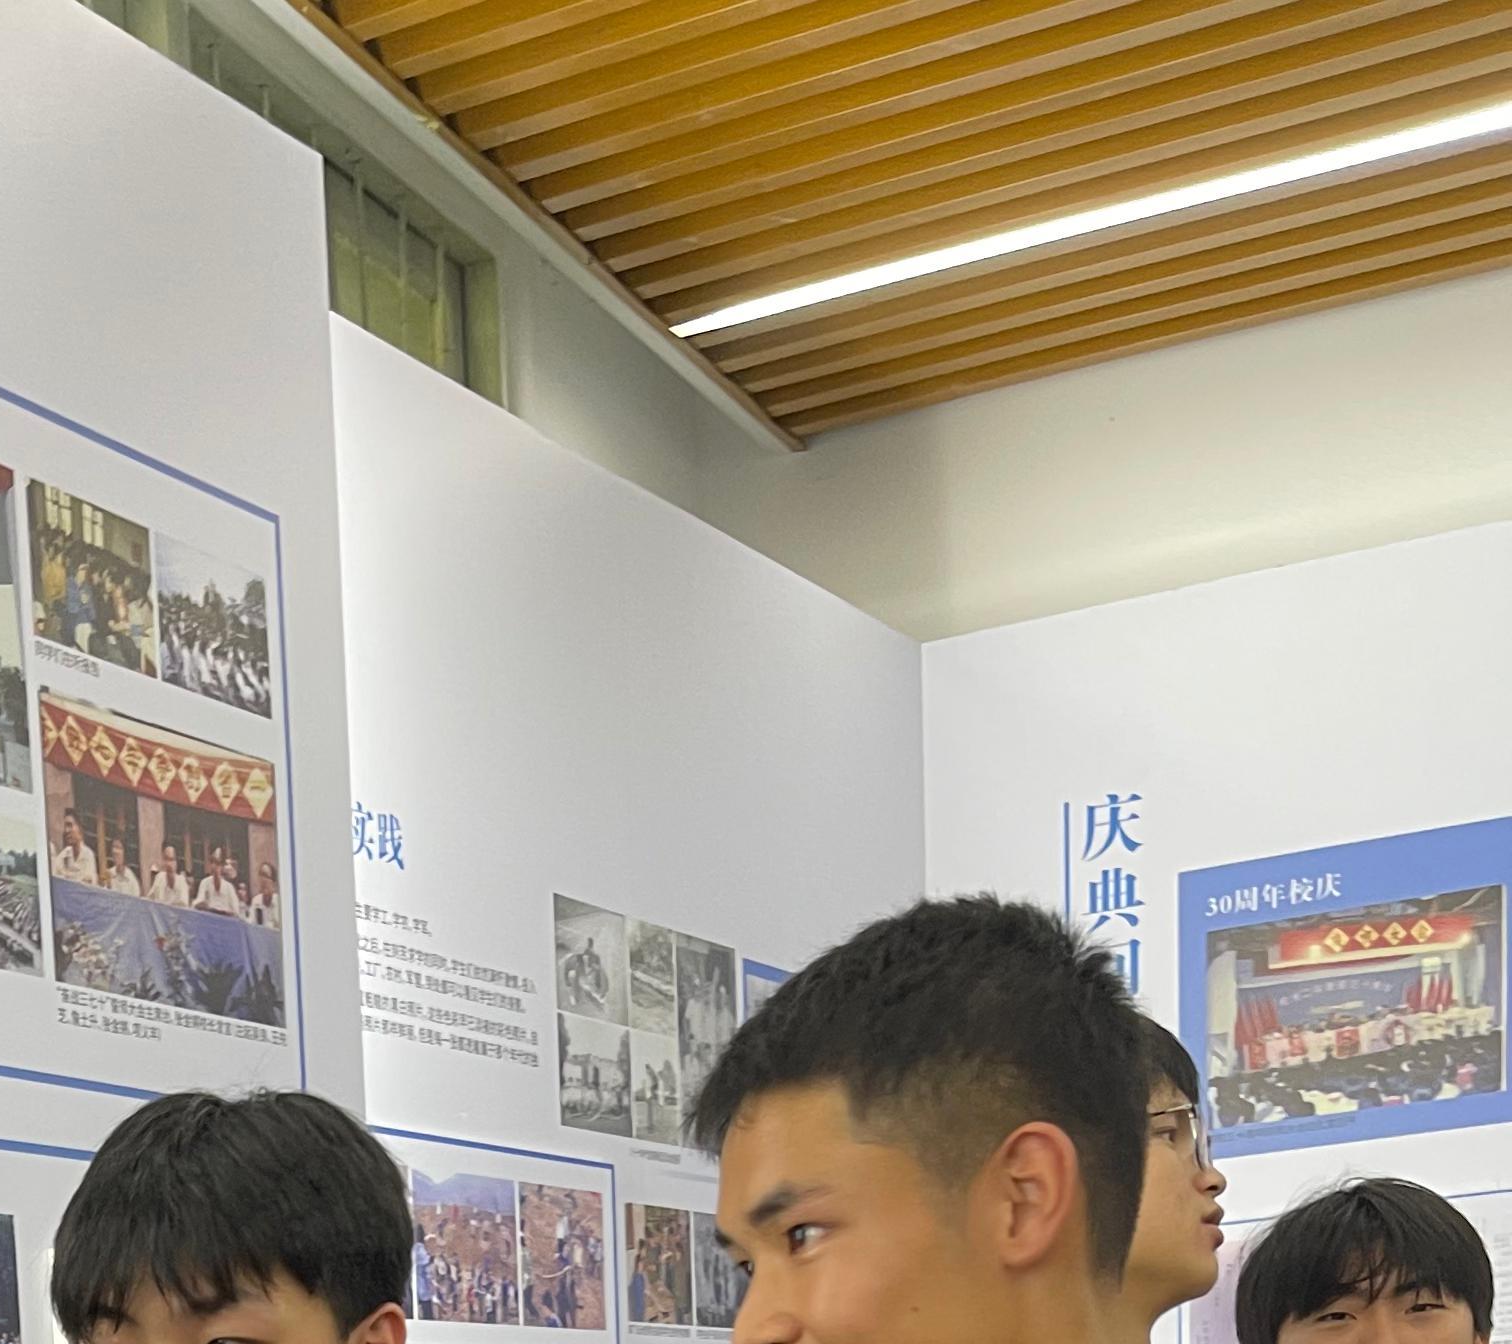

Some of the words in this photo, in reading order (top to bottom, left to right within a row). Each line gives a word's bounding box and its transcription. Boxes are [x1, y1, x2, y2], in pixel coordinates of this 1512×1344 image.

[351, 801, 405, 870] 实践
[1205, 873, 1342, 917] 30周年校庆
